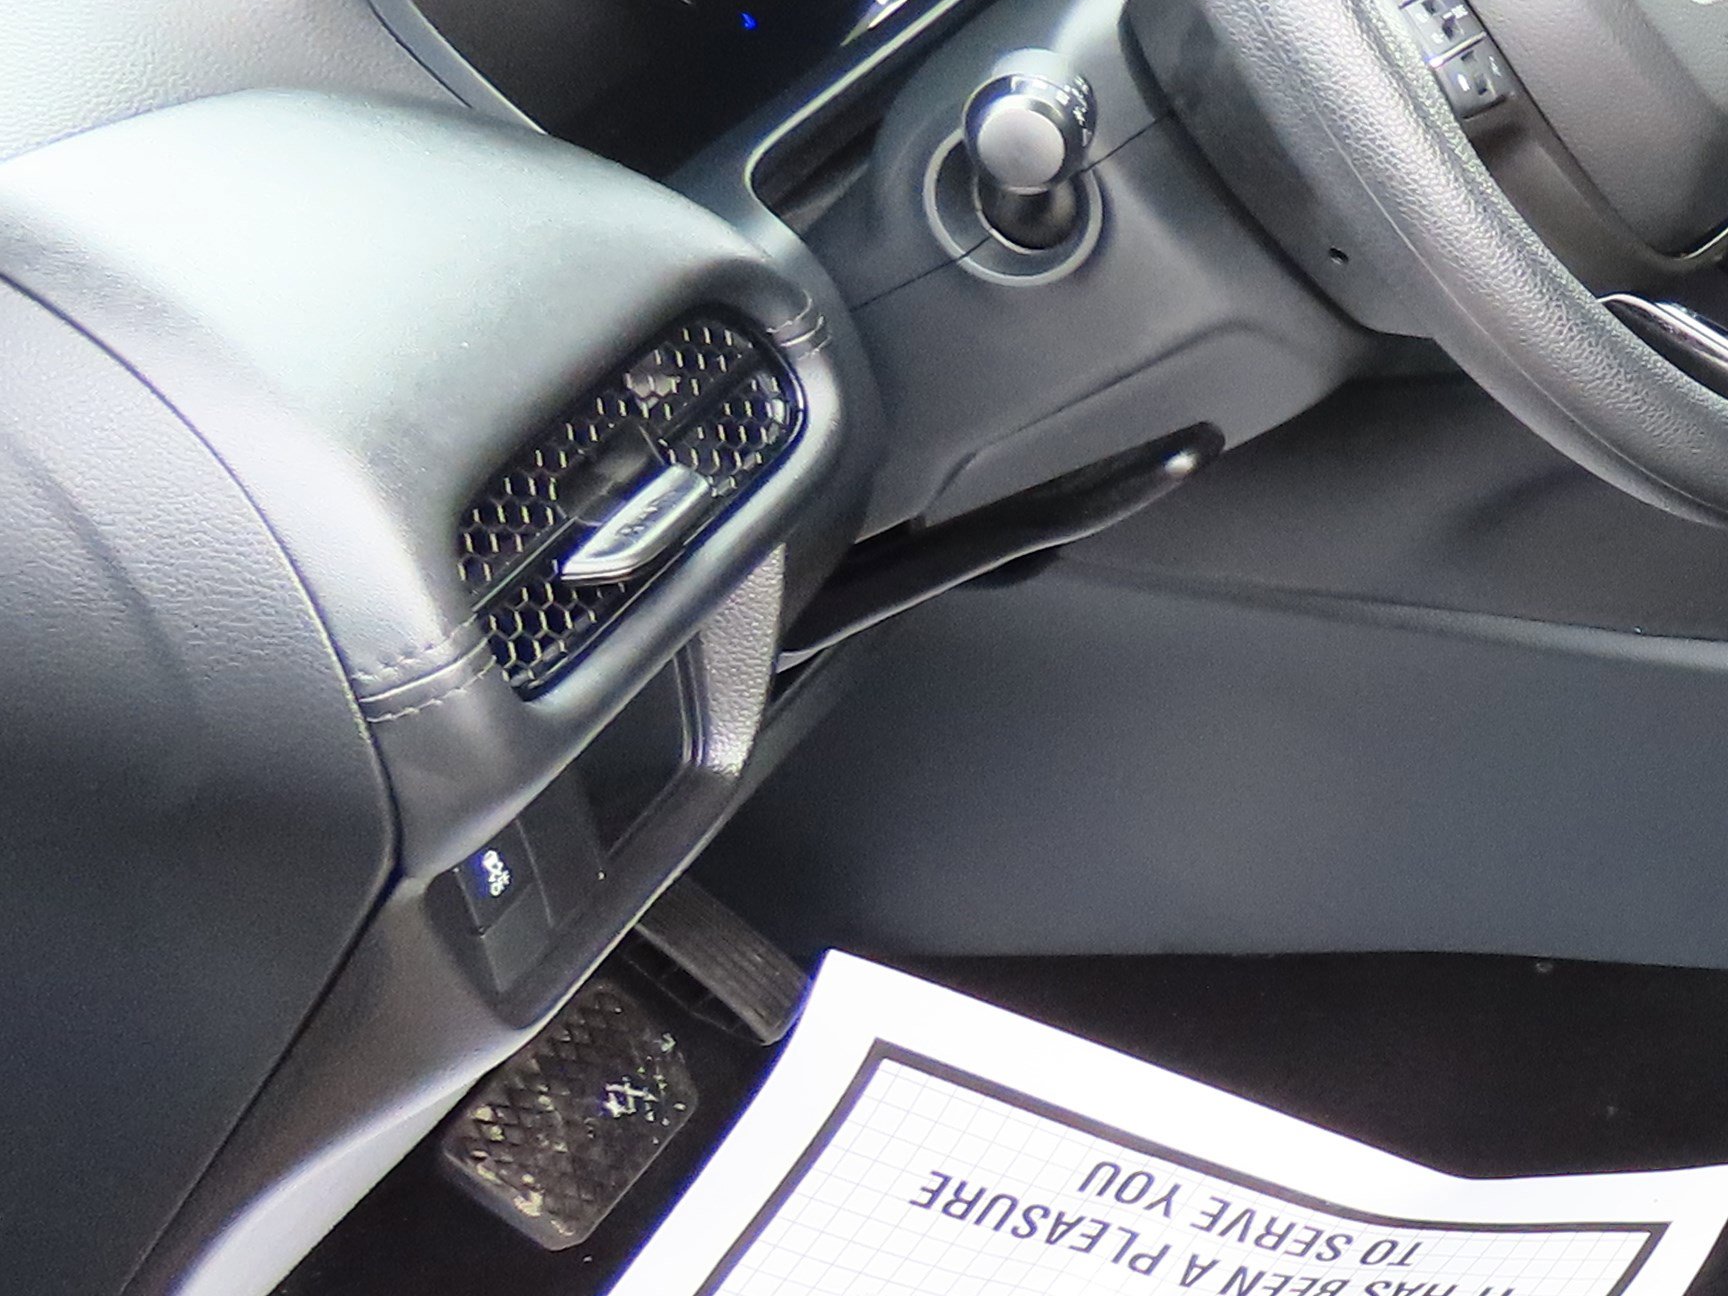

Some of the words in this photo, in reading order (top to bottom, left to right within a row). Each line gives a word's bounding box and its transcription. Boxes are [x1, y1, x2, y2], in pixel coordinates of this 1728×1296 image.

[1076, 1157, 1179, 1217] YOU
[907, 1168, 1170, 1275] PLEASURE
[1190, 1194, 1353, 1262] SERVE
[1177, 1252, 1218, 1286] A
[1358, 1238, 1422, 1266] TO
